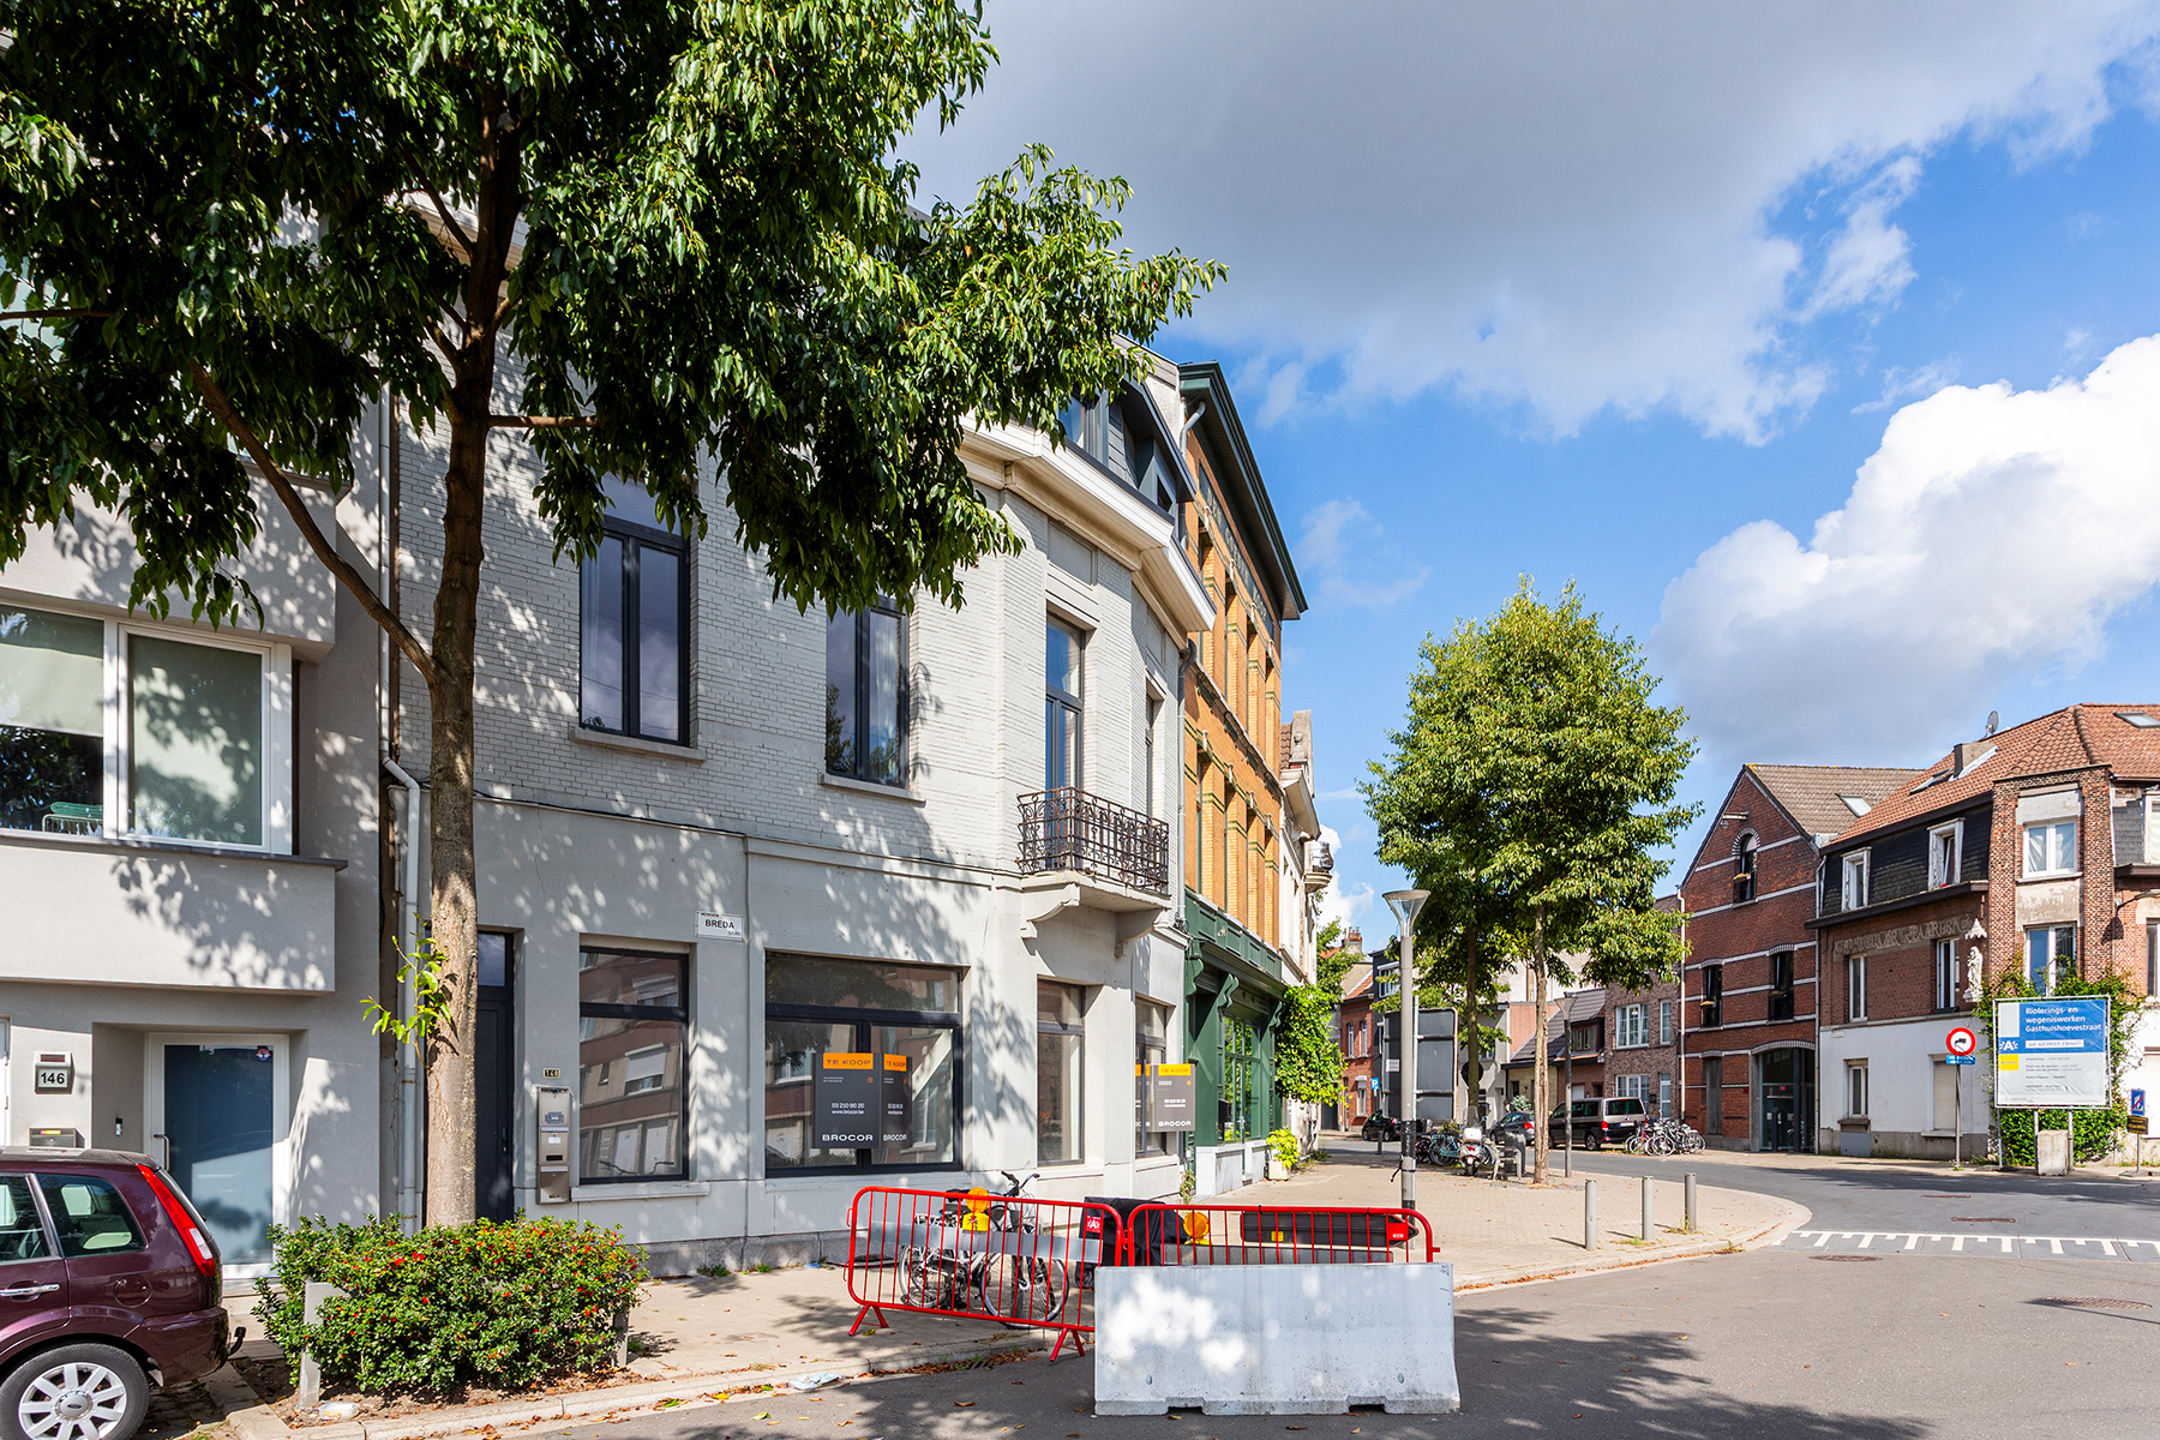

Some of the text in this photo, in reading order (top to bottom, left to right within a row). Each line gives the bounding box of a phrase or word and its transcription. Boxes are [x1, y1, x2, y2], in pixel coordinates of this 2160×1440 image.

[705, 919, 735, 929] BREDA
[2025, 1007, 2066, 1015] Riolerings-
[2025, 1015, 2086, 1024] wegeniswerken
[2025, 1024, 2102, 1032] Gasthuishoevestraat
[41, 1072, 65, 1084] 146
